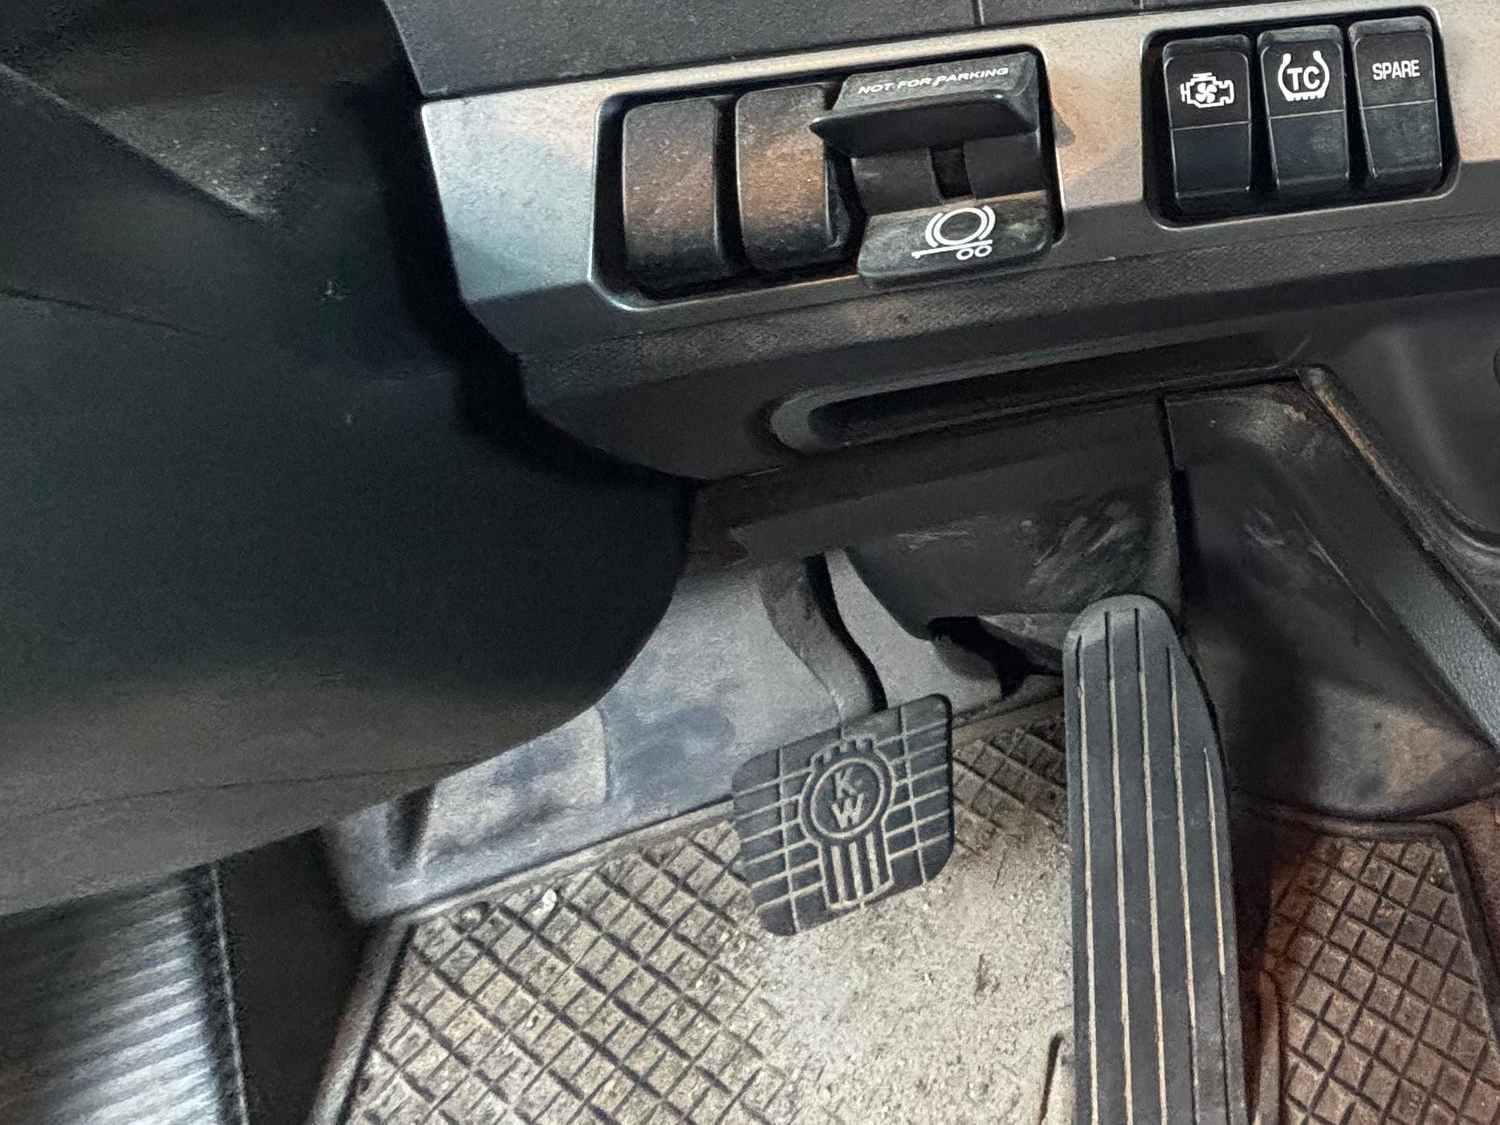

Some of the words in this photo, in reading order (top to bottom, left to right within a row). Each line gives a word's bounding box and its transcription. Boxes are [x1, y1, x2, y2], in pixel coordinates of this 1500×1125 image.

[857, 81, 895, 94] NOT
[896, 77, 933, 91] FOR
[933, 67, 1009, 86] PARKING
[1286, 65, 1321, 92] TC
[1372, 59, 1421, 82] SPARE
